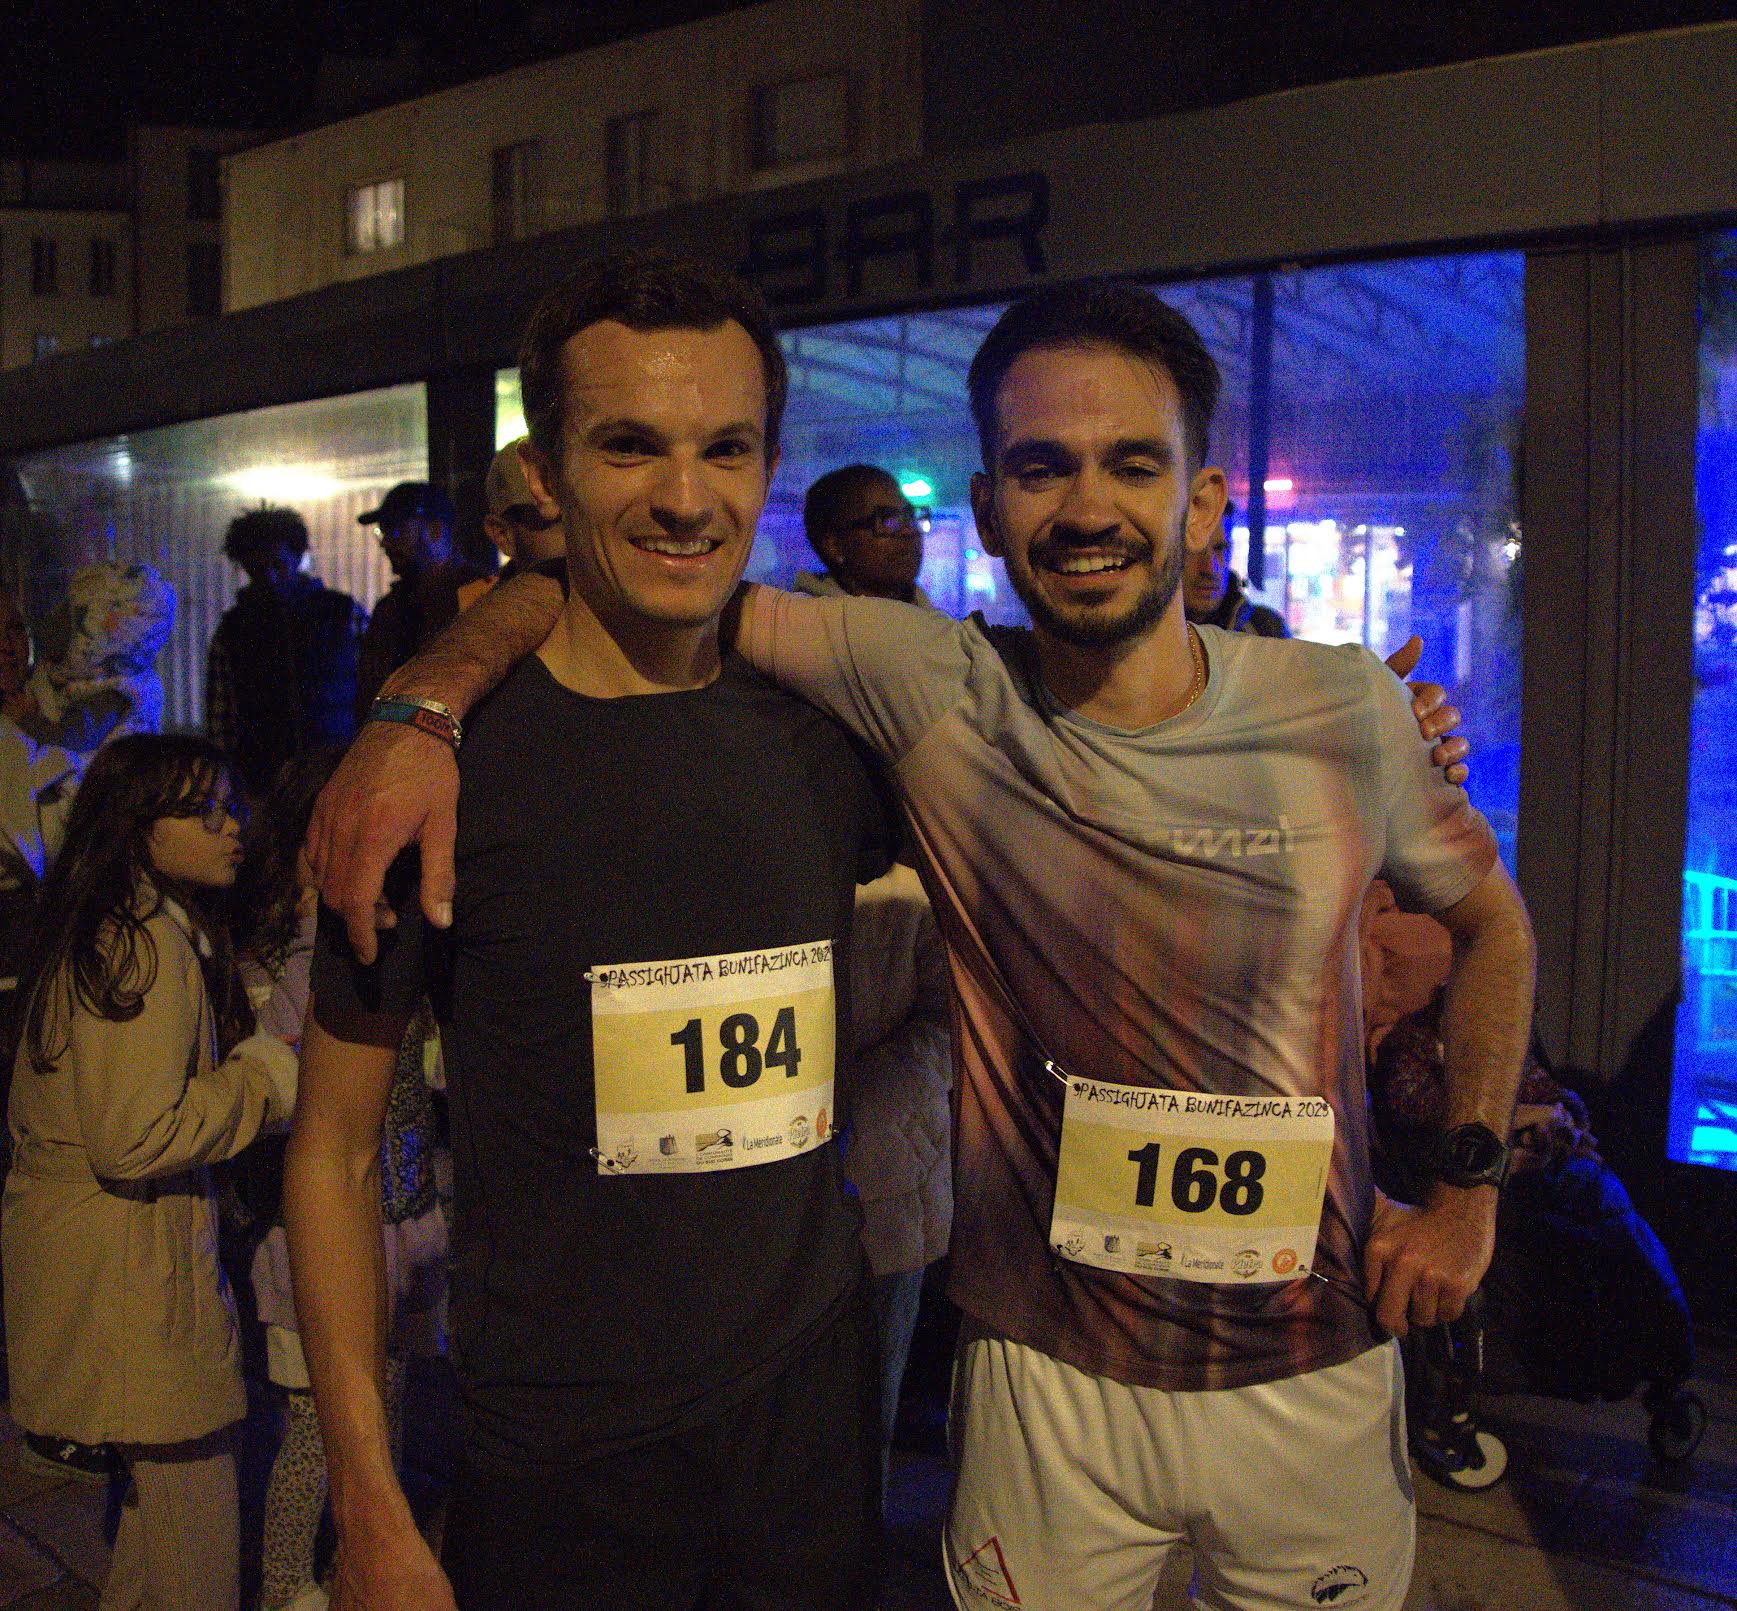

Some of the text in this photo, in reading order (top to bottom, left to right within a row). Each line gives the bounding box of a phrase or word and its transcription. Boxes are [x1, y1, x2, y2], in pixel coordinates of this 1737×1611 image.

[735, 172, 1050, 306] BAR
[718, 949, 809, 977] BUNIFAZINCA
[671, 1007, 802, 1094] 184
[1184, 1096, 1292, 1119] BUNIFAZINCA
[1127, 1142, 1267, 1216] 168
